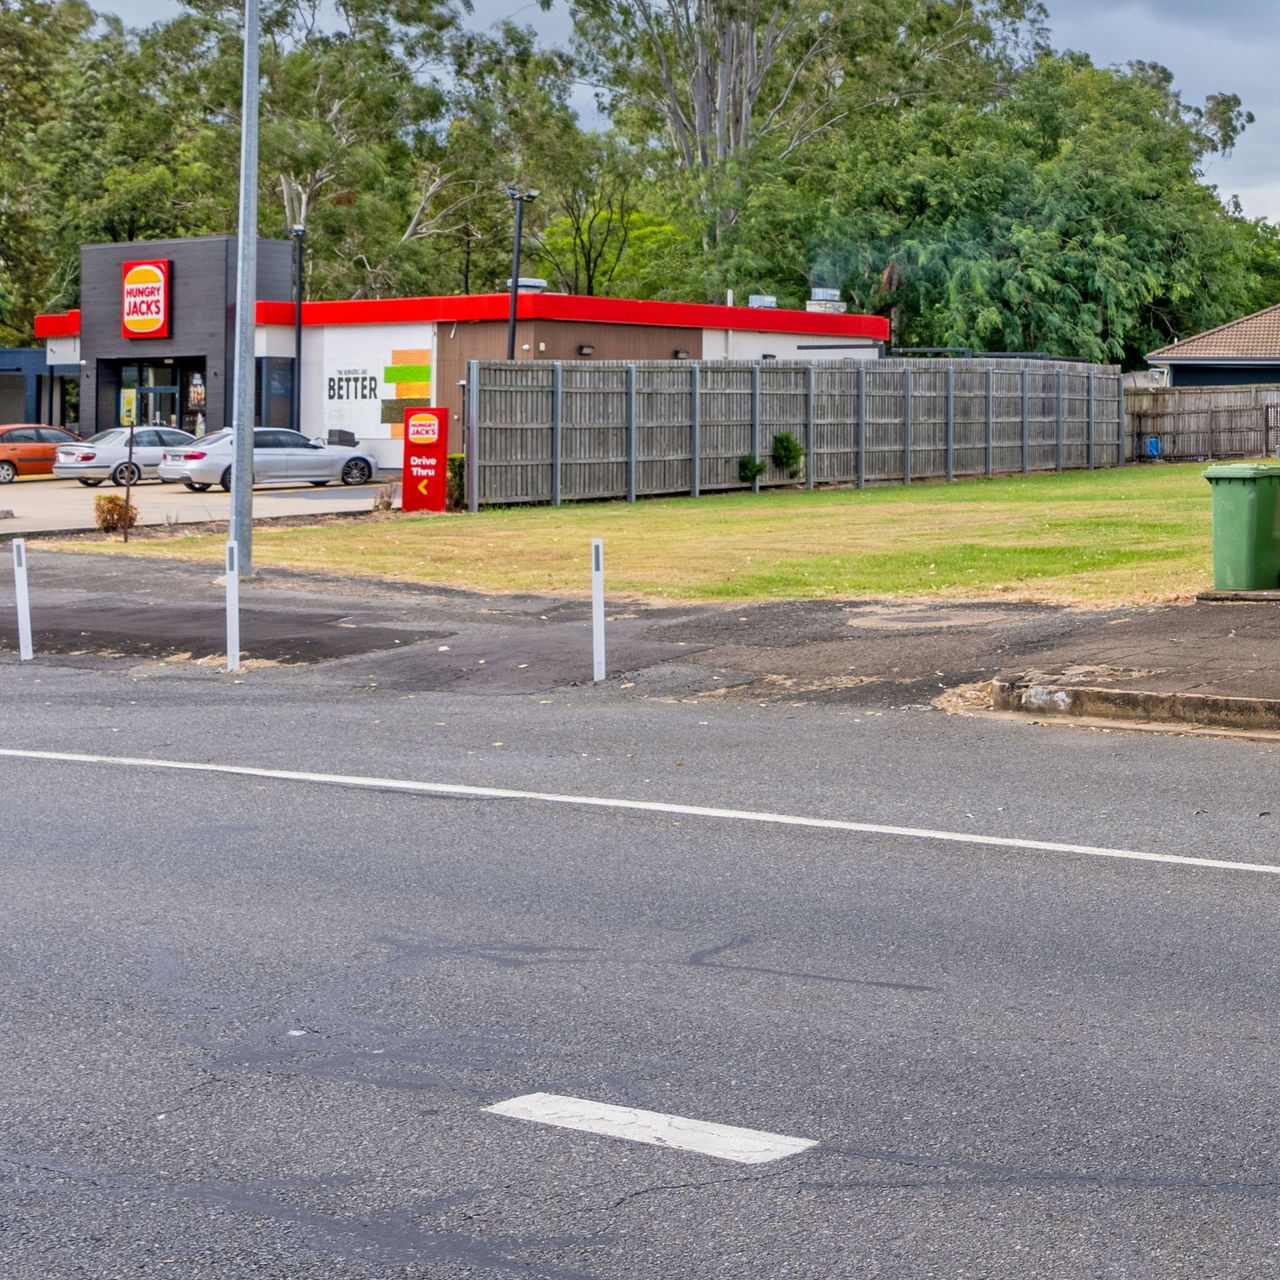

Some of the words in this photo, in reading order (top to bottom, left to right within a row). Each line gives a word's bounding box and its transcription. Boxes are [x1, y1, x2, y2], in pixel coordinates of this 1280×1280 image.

[126, 287, 161, 298] HUNGRY
[328, 376, 377, 400] BETTER
[410, 456, 437, 465] Drive
[411, 467, 435, 476] Thru
